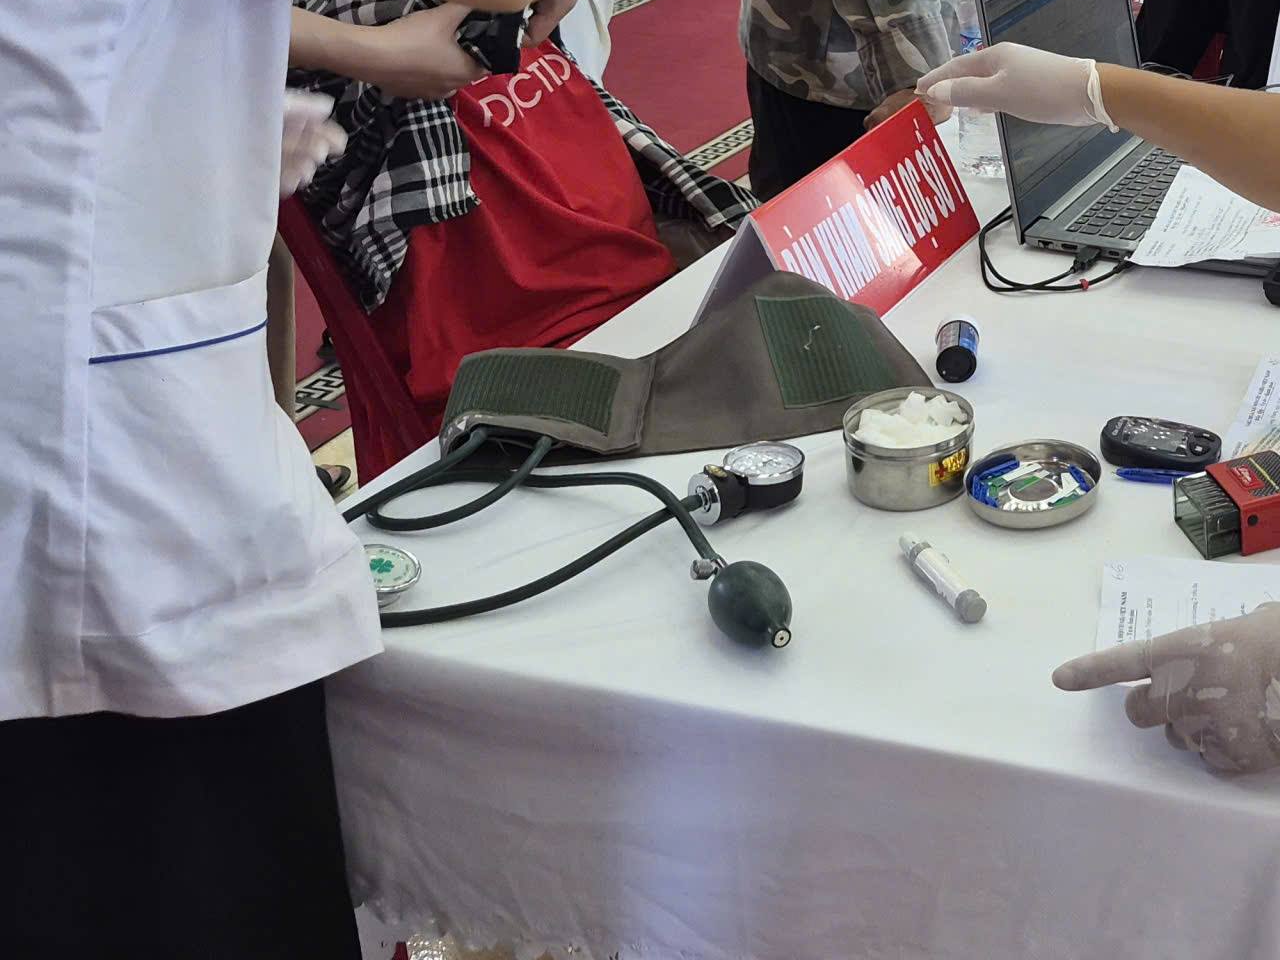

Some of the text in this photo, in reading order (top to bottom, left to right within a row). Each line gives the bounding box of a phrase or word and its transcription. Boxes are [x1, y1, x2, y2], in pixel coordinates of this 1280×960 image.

[890, 157, 939, 248] LỌC
[914, 118, 956, 218] SỐ
[934, 139, 965, 204] 1
[813, 195, 882, 301] KHÁM
[856, 173, 917, 267] SÀNG
